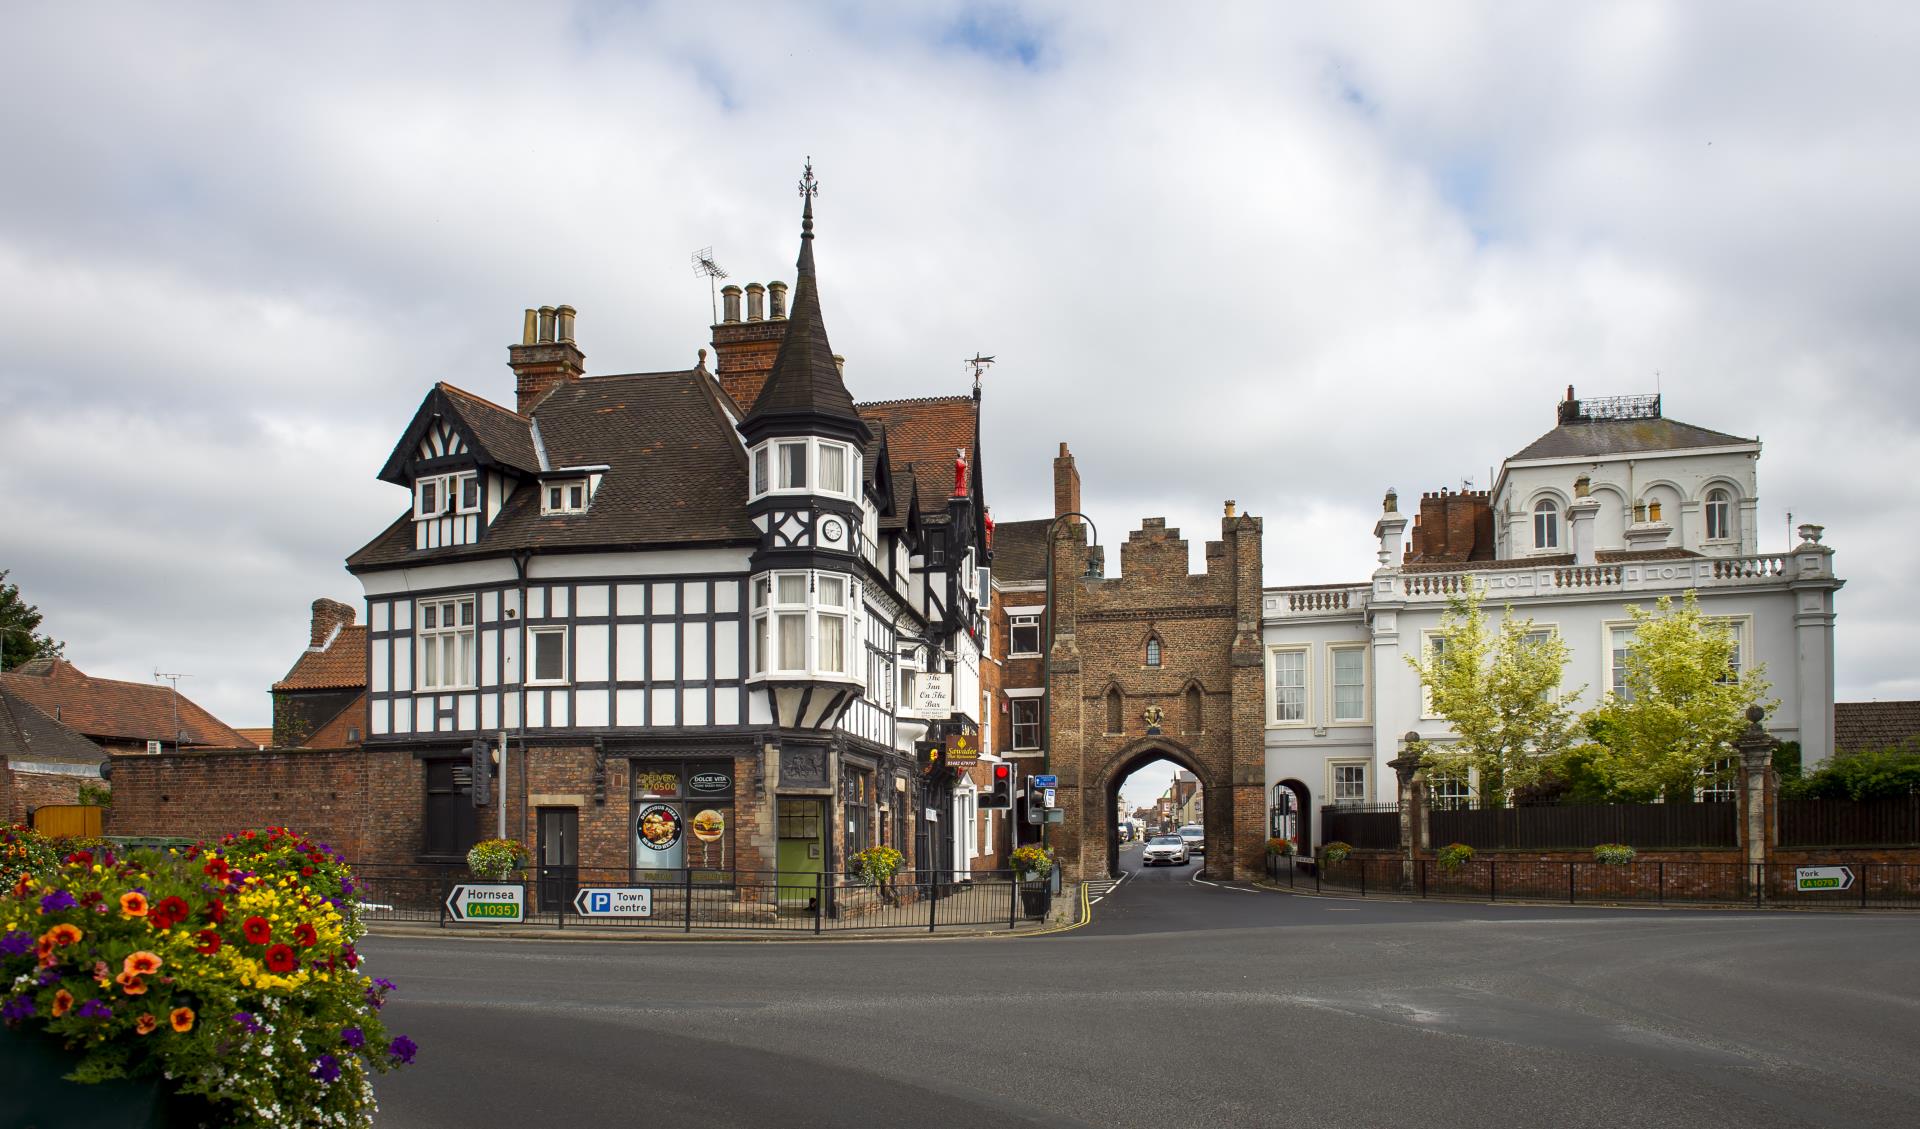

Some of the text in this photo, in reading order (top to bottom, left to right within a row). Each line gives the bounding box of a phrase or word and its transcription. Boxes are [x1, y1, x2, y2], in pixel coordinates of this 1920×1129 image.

[920, 691, 930, 699] On
[640, 805, 678, 820] DELICIOUS PIZZA
[468, 889, 514, 900] Hornsea
[617, 892, 644, 901] Town
[468, 903, 517, 916] (A1035)
[613, 903, 647, 912] centre
